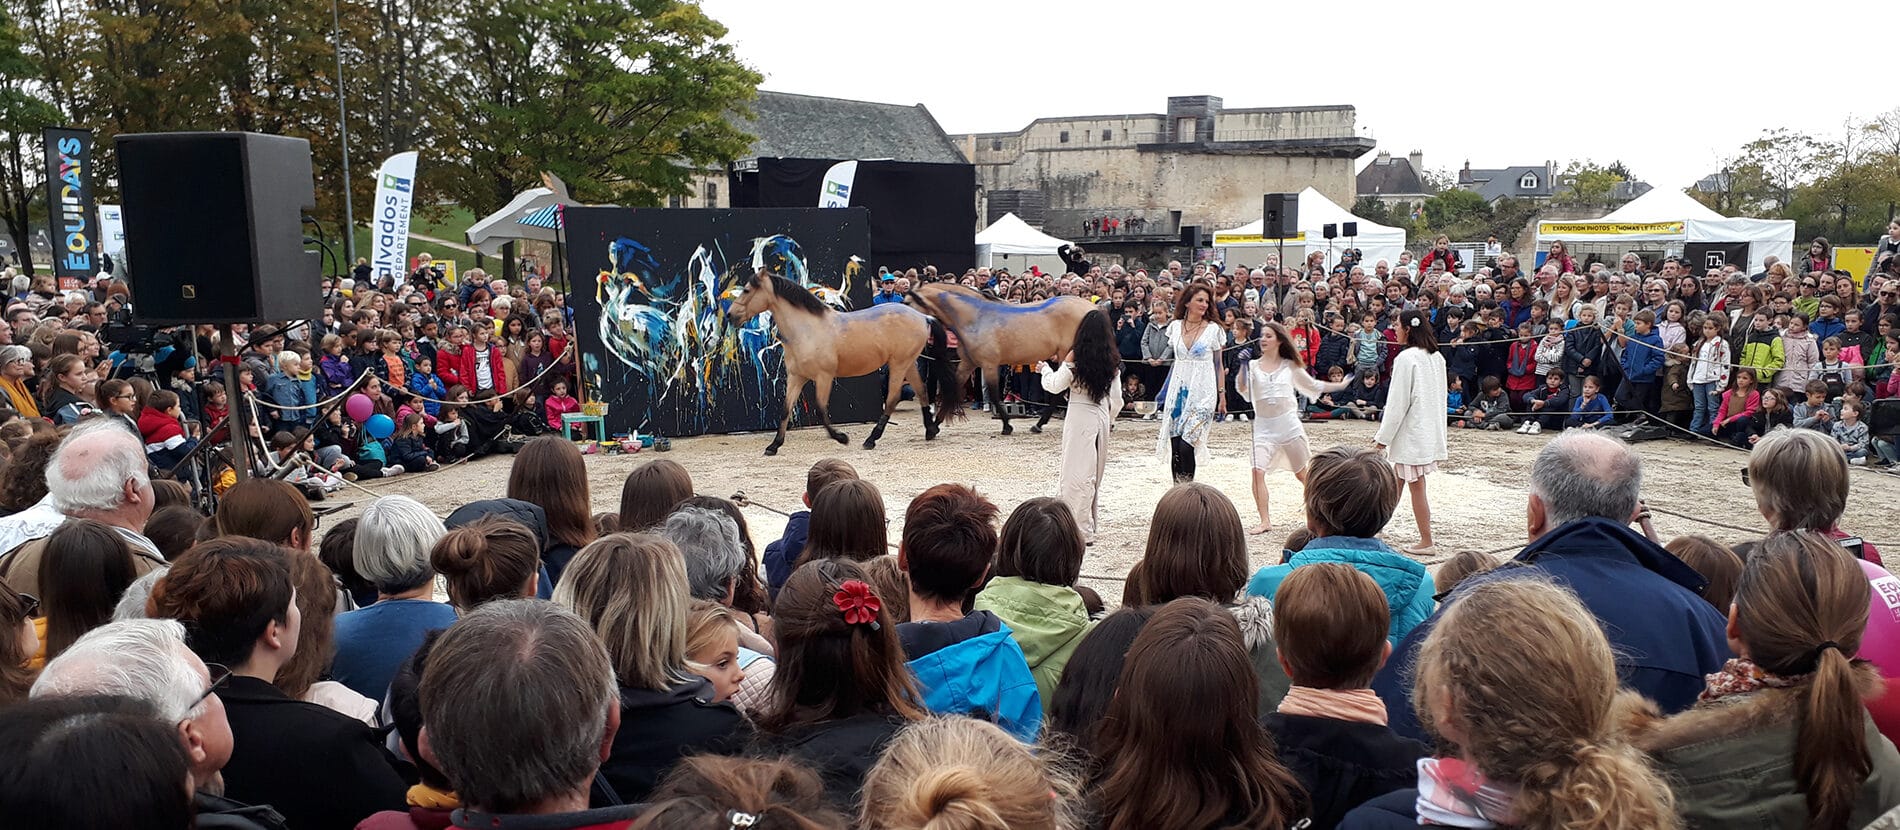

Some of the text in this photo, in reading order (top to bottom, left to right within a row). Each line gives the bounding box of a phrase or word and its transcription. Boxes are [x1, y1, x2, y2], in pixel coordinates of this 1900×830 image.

[58, 137, 90, 270] ÉQUIDAYS
[376, 195, 397, 276] alvados
[395, 199, 409, 278] DÉPARTEMENT
[1707, 255, 1723, 266] Th
